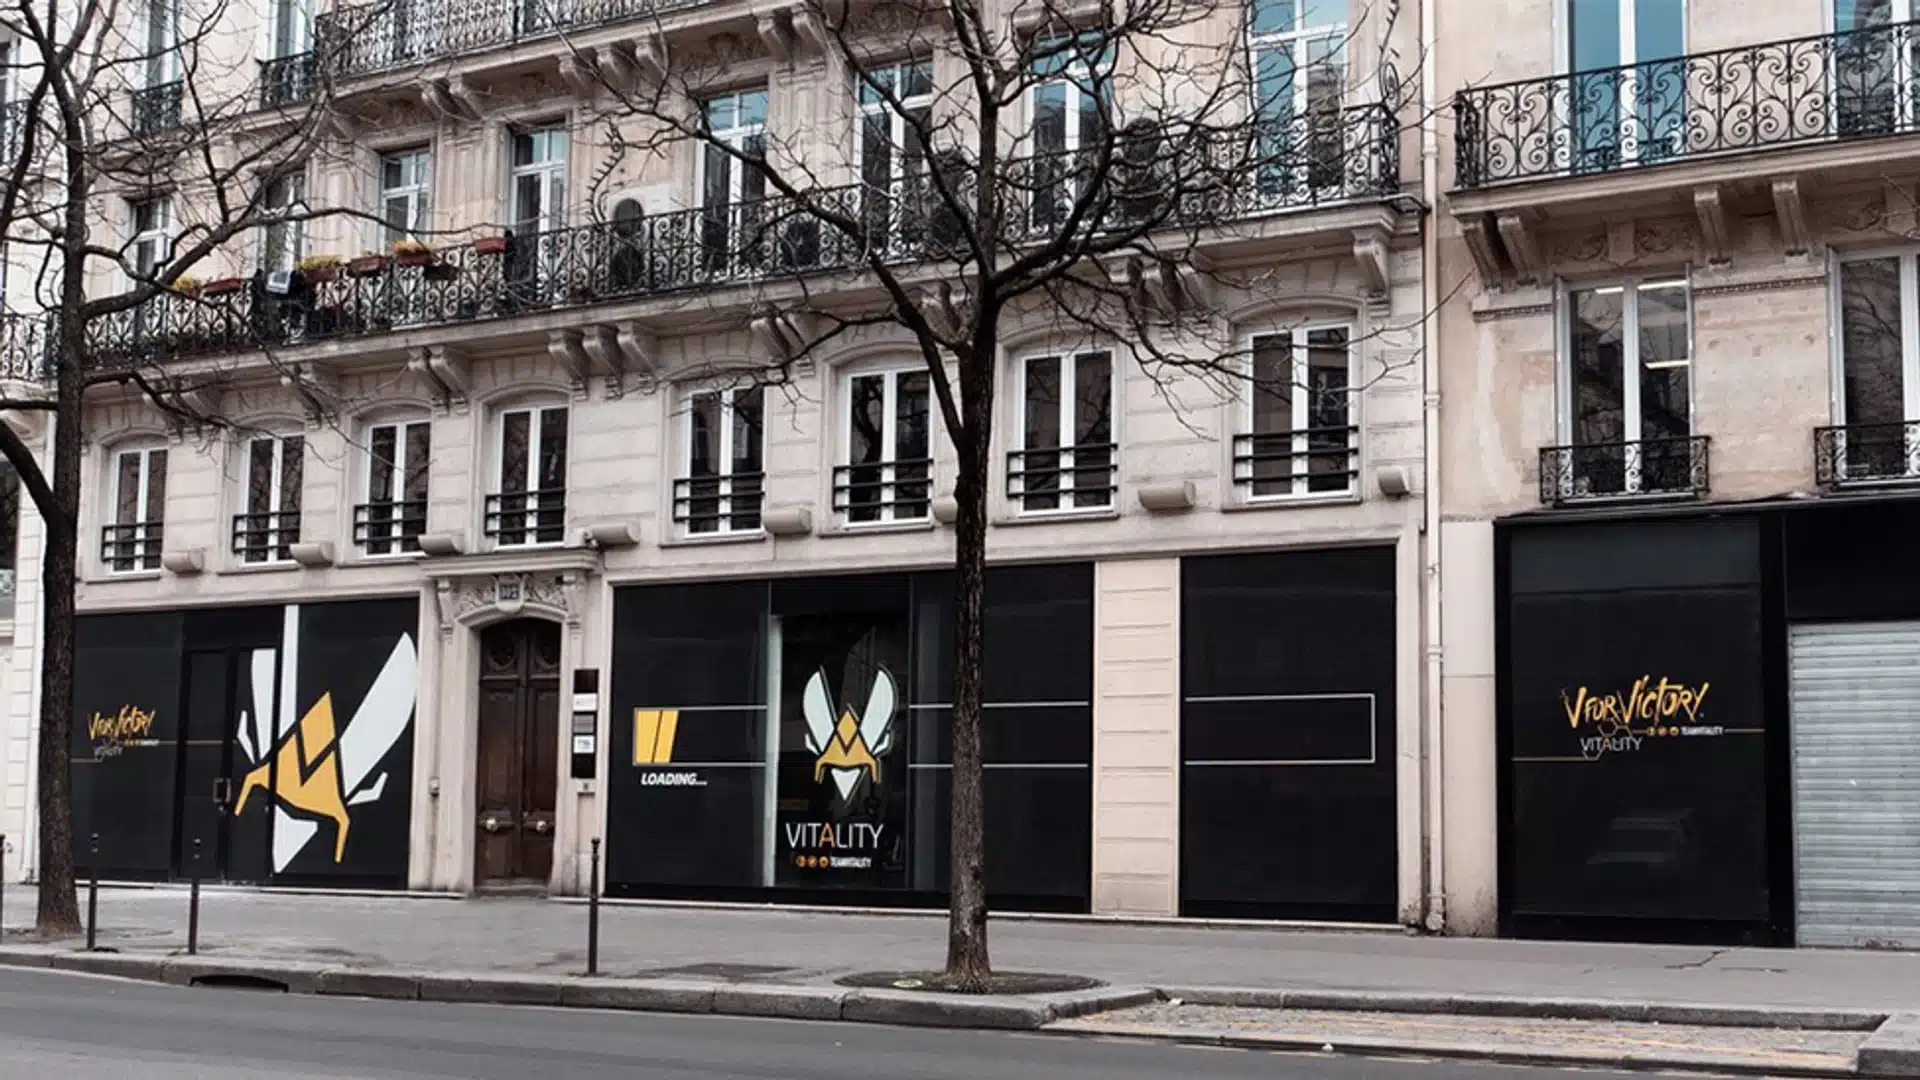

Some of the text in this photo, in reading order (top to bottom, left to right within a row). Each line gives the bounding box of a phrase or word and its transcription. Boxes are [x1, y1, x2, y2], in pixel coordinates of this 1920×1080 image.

[1561, 685, 1588, 728] V
[1579, 736, 1643, 752] VITALITY
[784, 821, 884, 849] VITALITY
